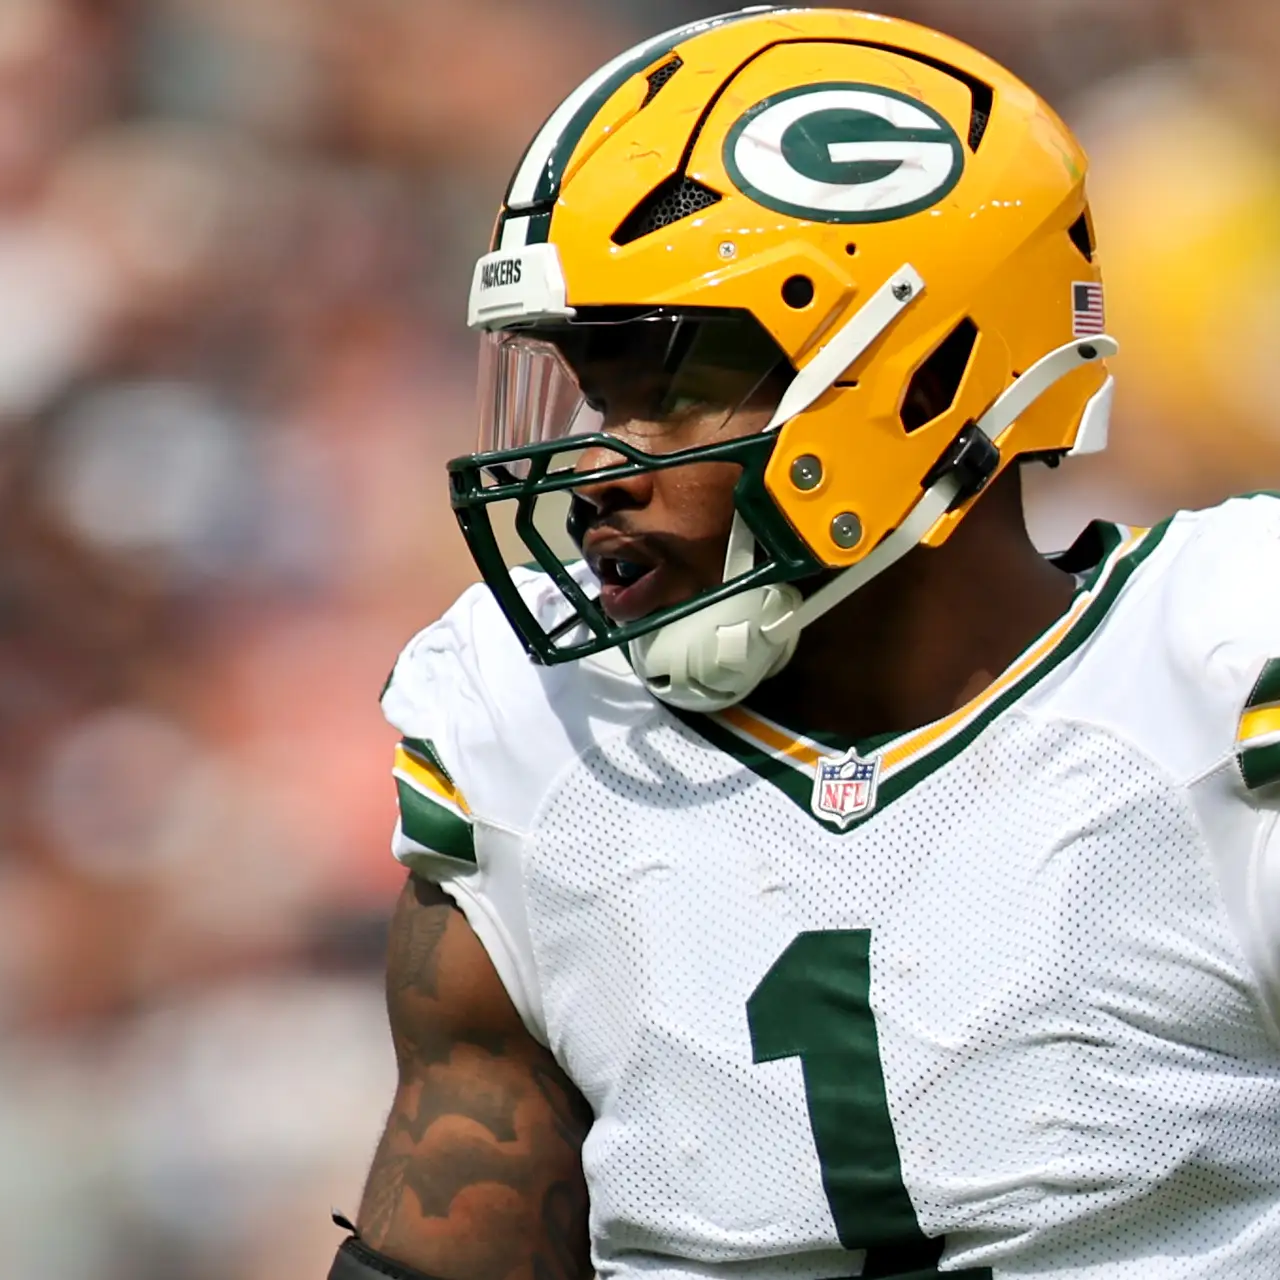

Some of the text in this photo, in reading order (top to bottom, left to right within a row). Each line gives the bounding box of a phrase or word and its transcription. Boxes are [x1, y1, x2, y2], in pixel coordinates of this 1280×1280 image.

[732, 88, 955, 213] G
[480, 258, 522, 292] PACKERS
[823, 782, 865, 812] NFL
